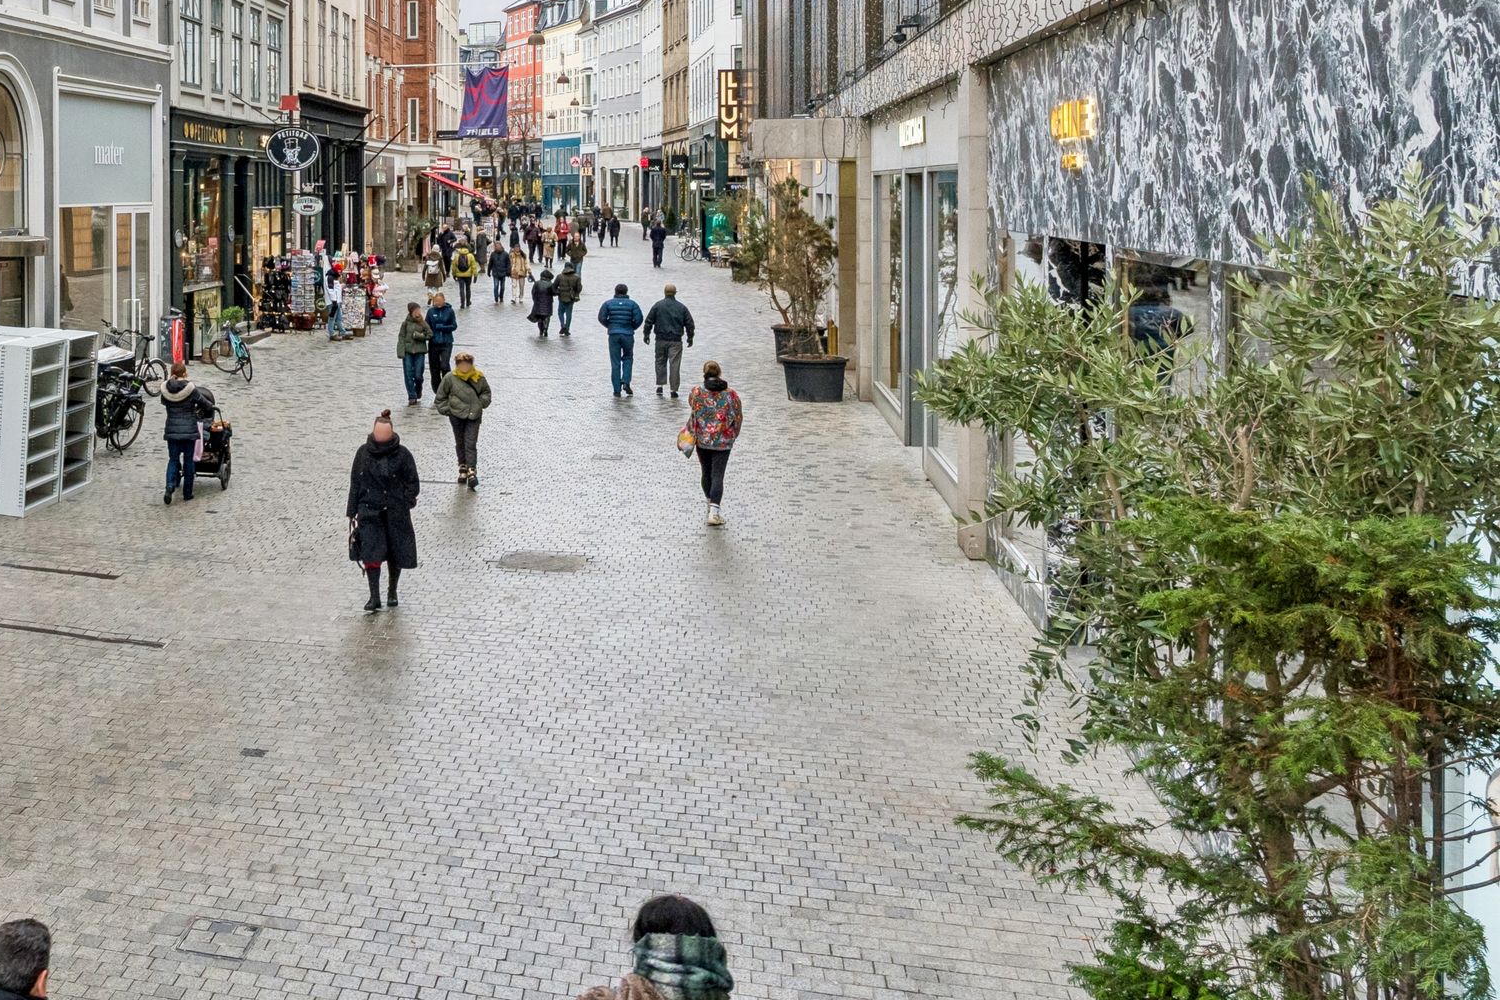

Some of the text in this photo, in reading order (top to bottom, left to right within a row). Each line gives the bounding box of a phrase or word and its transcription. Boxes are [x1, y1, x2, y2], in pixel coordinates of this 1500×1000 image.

[720, 71, 738, 139] ILLUM
[466, 127, 500, 136] THIELE
[94, 141, 125, 165] mater
